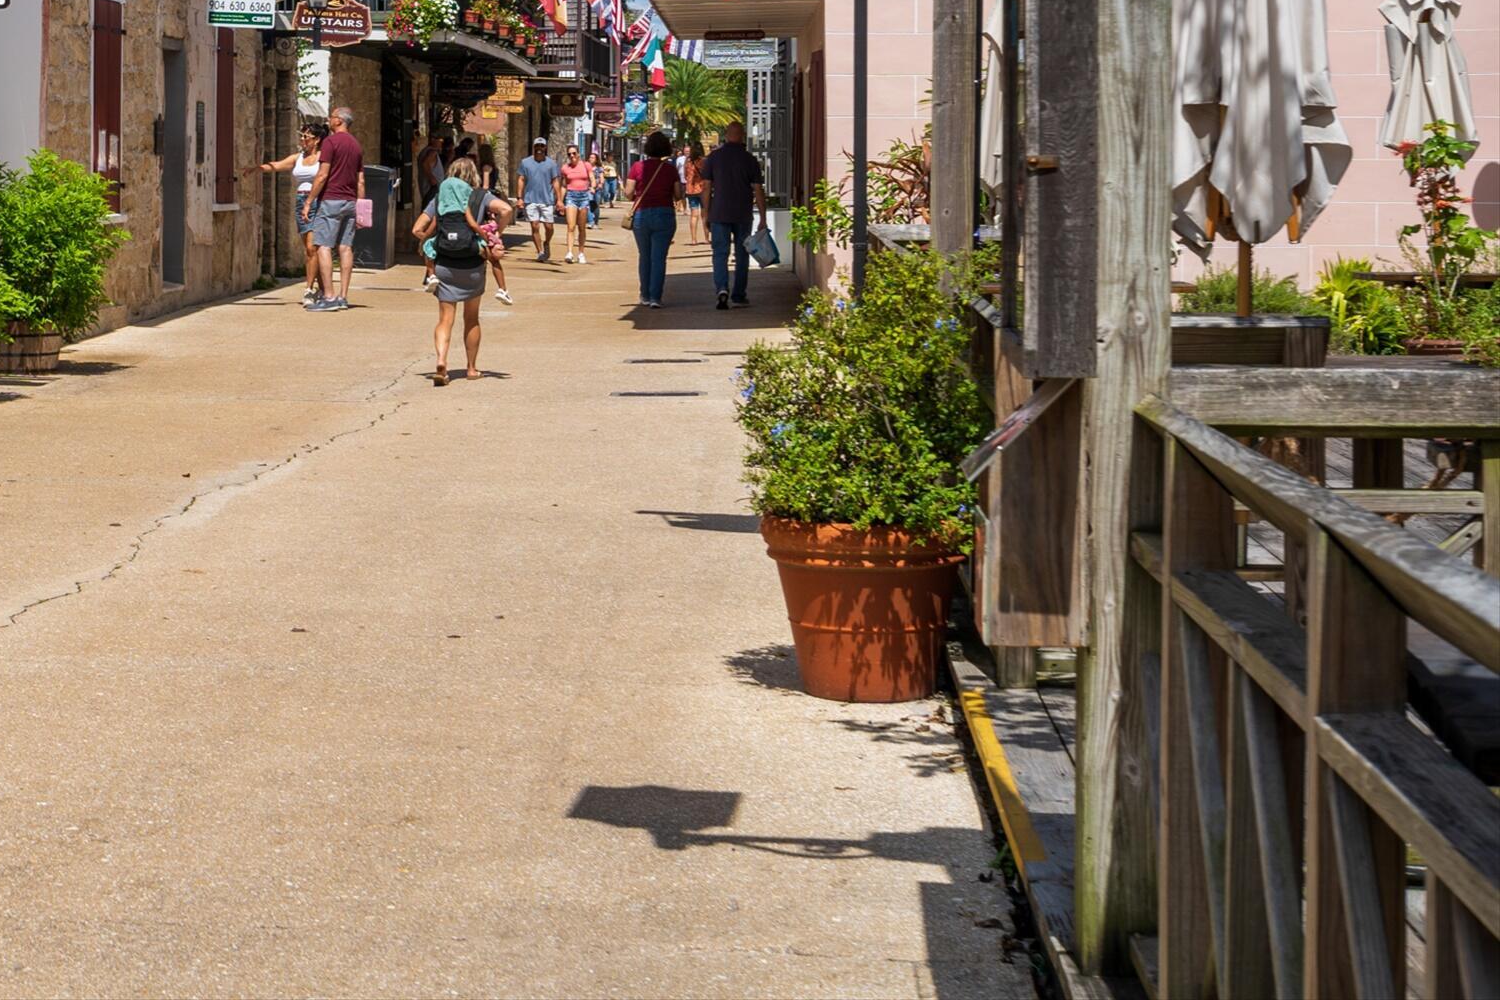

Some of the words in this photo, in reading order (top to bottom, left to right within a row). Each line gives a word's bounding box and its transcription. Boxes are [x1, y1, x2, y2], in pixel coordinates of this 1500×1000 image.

[208, 0, 225, 10] 904
[229, 1, 246, 11] 630
[250, 2, 272, 12] 6360
